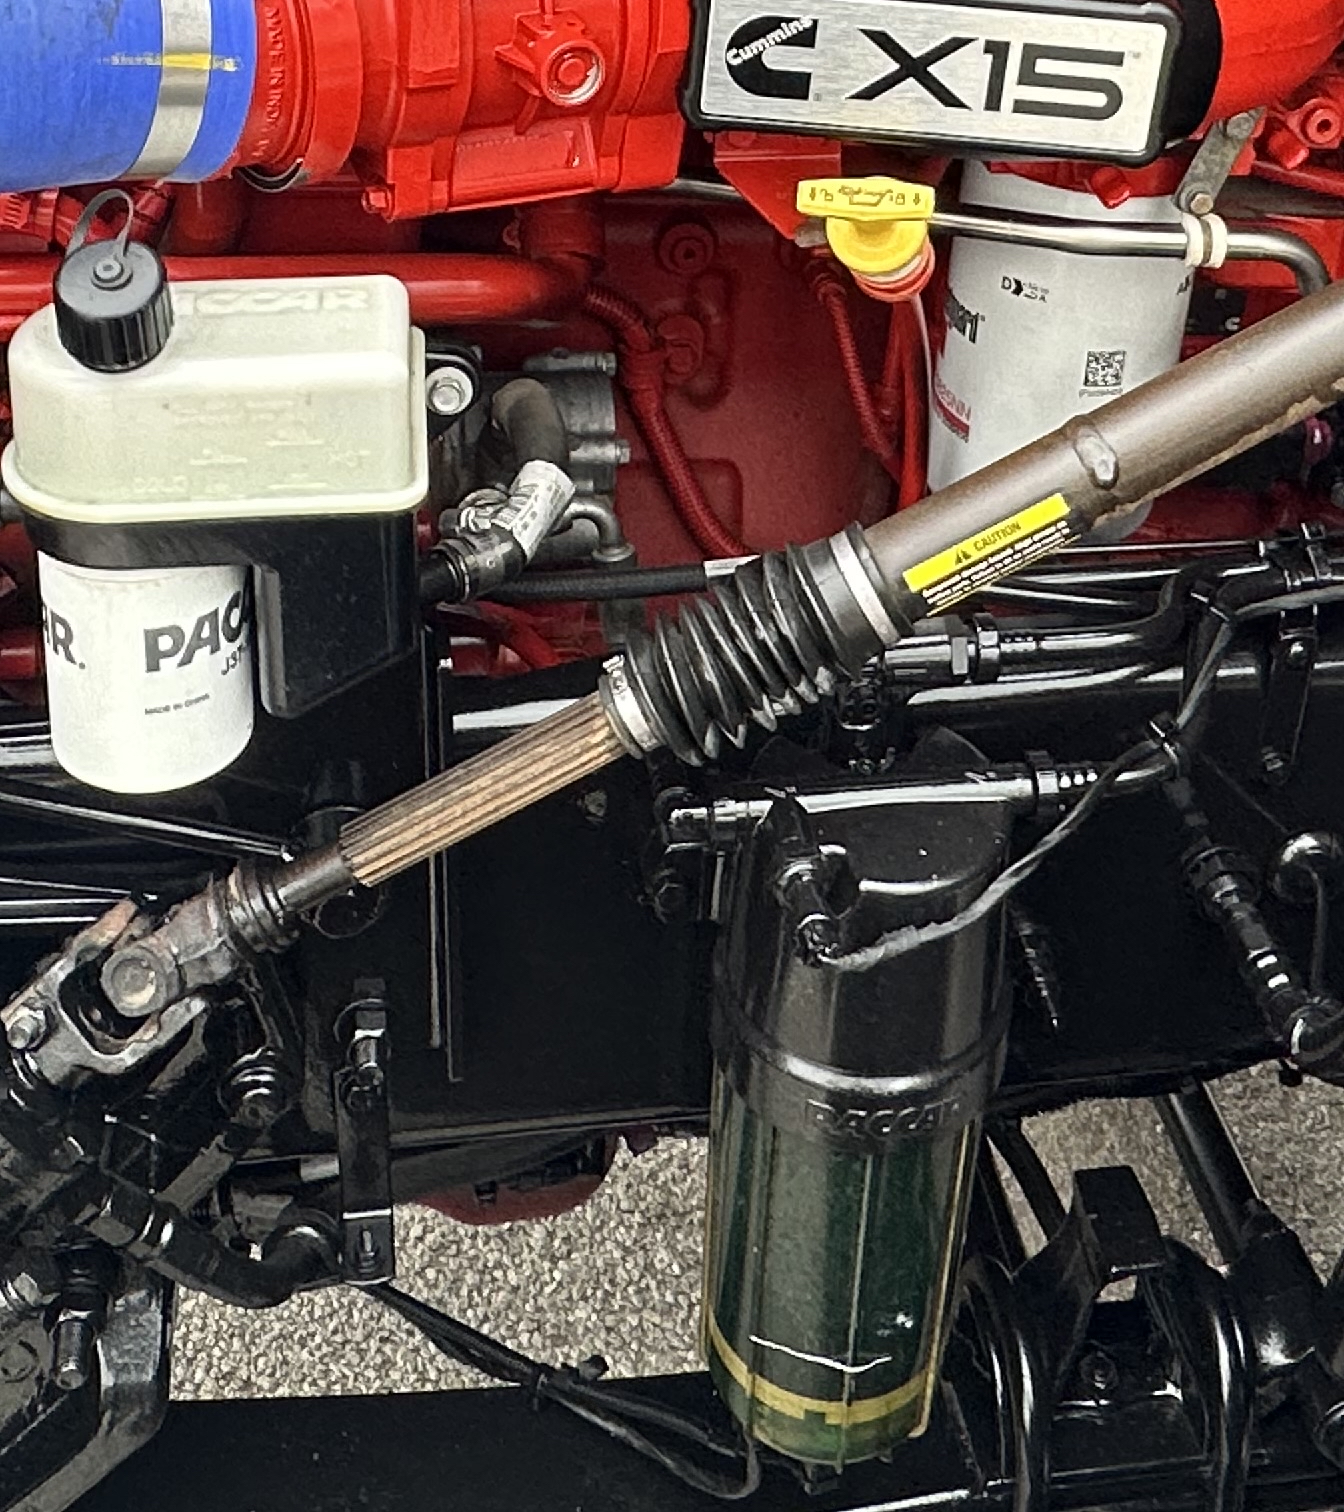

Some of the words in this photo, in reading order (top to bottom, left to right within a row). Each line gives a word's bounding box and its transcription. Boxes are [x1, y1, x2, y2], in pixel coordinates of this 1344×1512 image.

[726, 15, 814, 66] Cummins
[844, 27, 1126, 122] X15
[973, 520, 1022, 552] CAUTION
